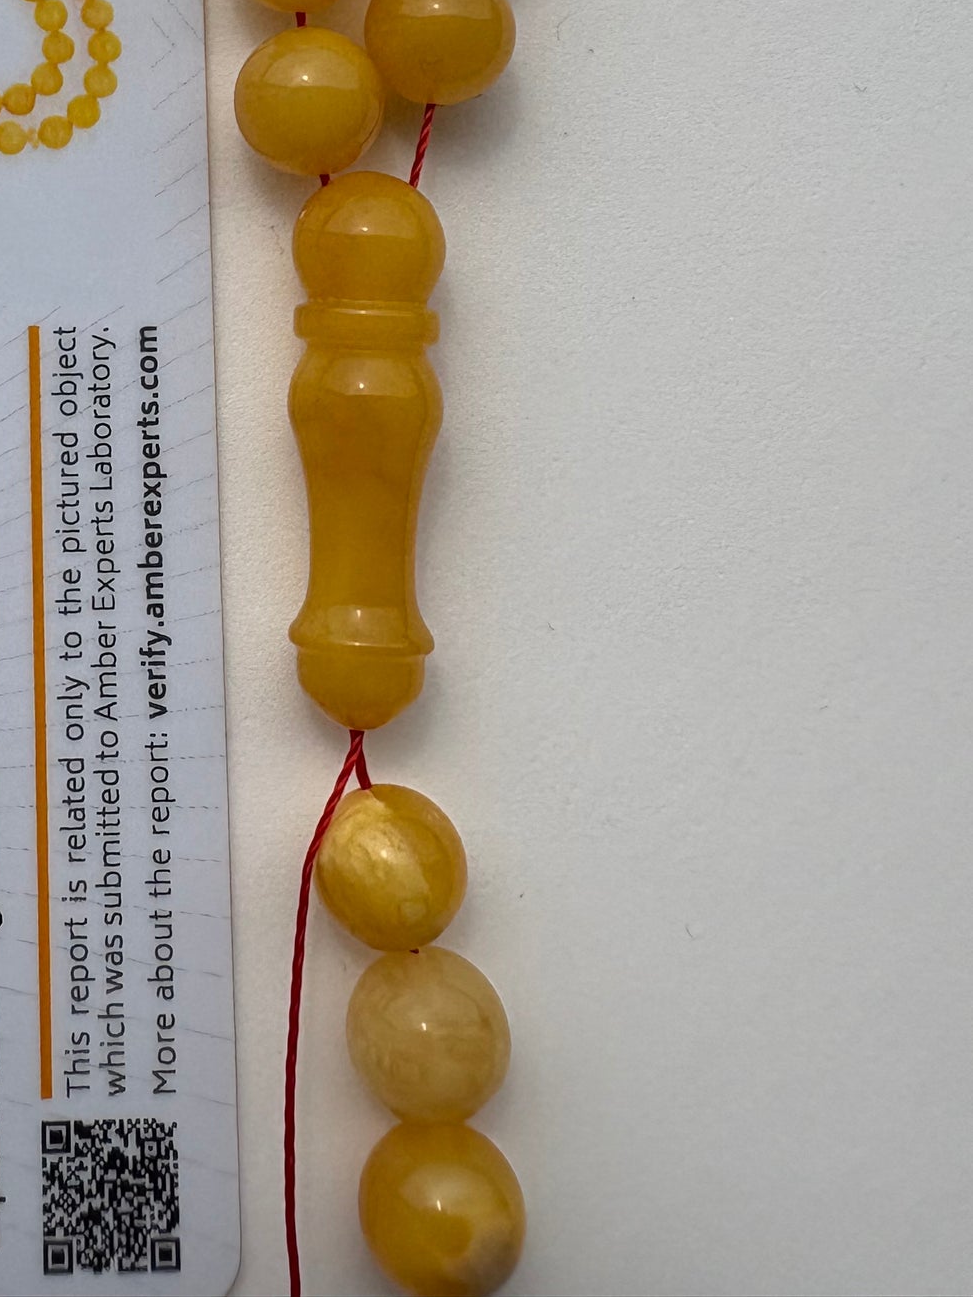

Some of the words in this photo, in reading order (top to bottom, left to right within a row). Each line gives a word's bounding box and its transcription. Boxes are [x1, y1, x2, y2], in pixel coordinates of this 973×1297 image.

[50, 326, 84, 417] object
[85, 327, 117, 491] Laboratory.
[51, 432, 88, 553] pictured
[134, 325, 173, 720] verify.amberexperts.com
[54, 568, 82, 616] the
[90, 500, 121, 611] Experts
[58, 631, 83, 662] to
[90, 620, 118, 722] Amber
[56, 675, 91, 741] only
[95, 730, 120, 761] to
[57, 757, 87, 863] related
[144, 732, 177, 835] report:
[61, 879, 88, 903] is
[92, 769, 123, 926] submitted
[144, 848, 172, 899] the
[63, 917, 96, 1015] report
[104, 934, 124, 995] was
[146, 909, 175, 1001] about
[63, 1031, 91, 1099] This
[97, 1002, 127, 1097] which
[151, 1013, 177, 1095] More
